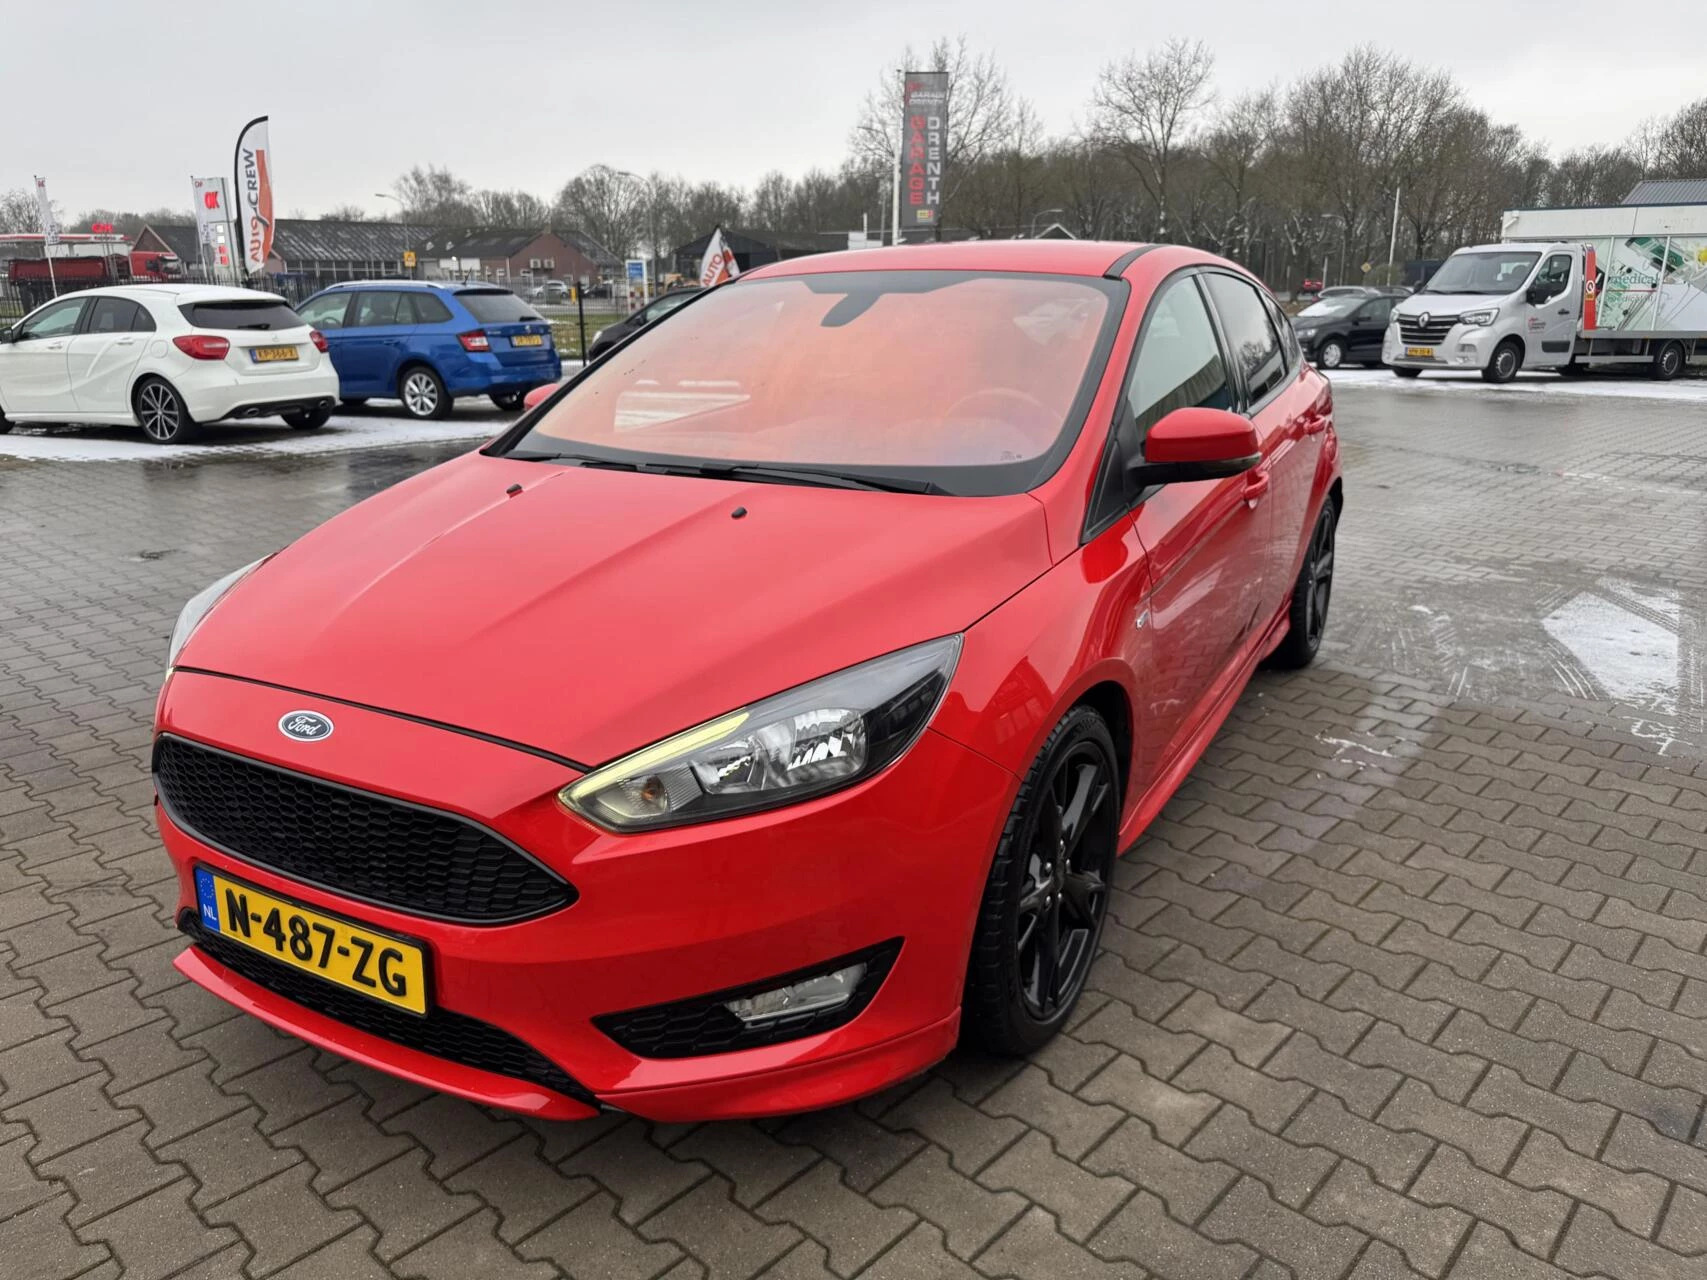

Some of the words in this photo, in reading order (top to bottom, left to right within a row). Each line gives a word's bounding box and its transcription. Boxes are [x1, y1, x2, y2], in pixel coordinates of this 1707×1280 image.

[910, 116, 925, 205] GARAGE
[927, 116, 941, 205] DRENTH
[702, 254, 724, 286] AUTO
[287, 715, 321, 736] Ford
[203, 903, 217, 921] NL
[225, 887, 407, 997] N-487-ZG
